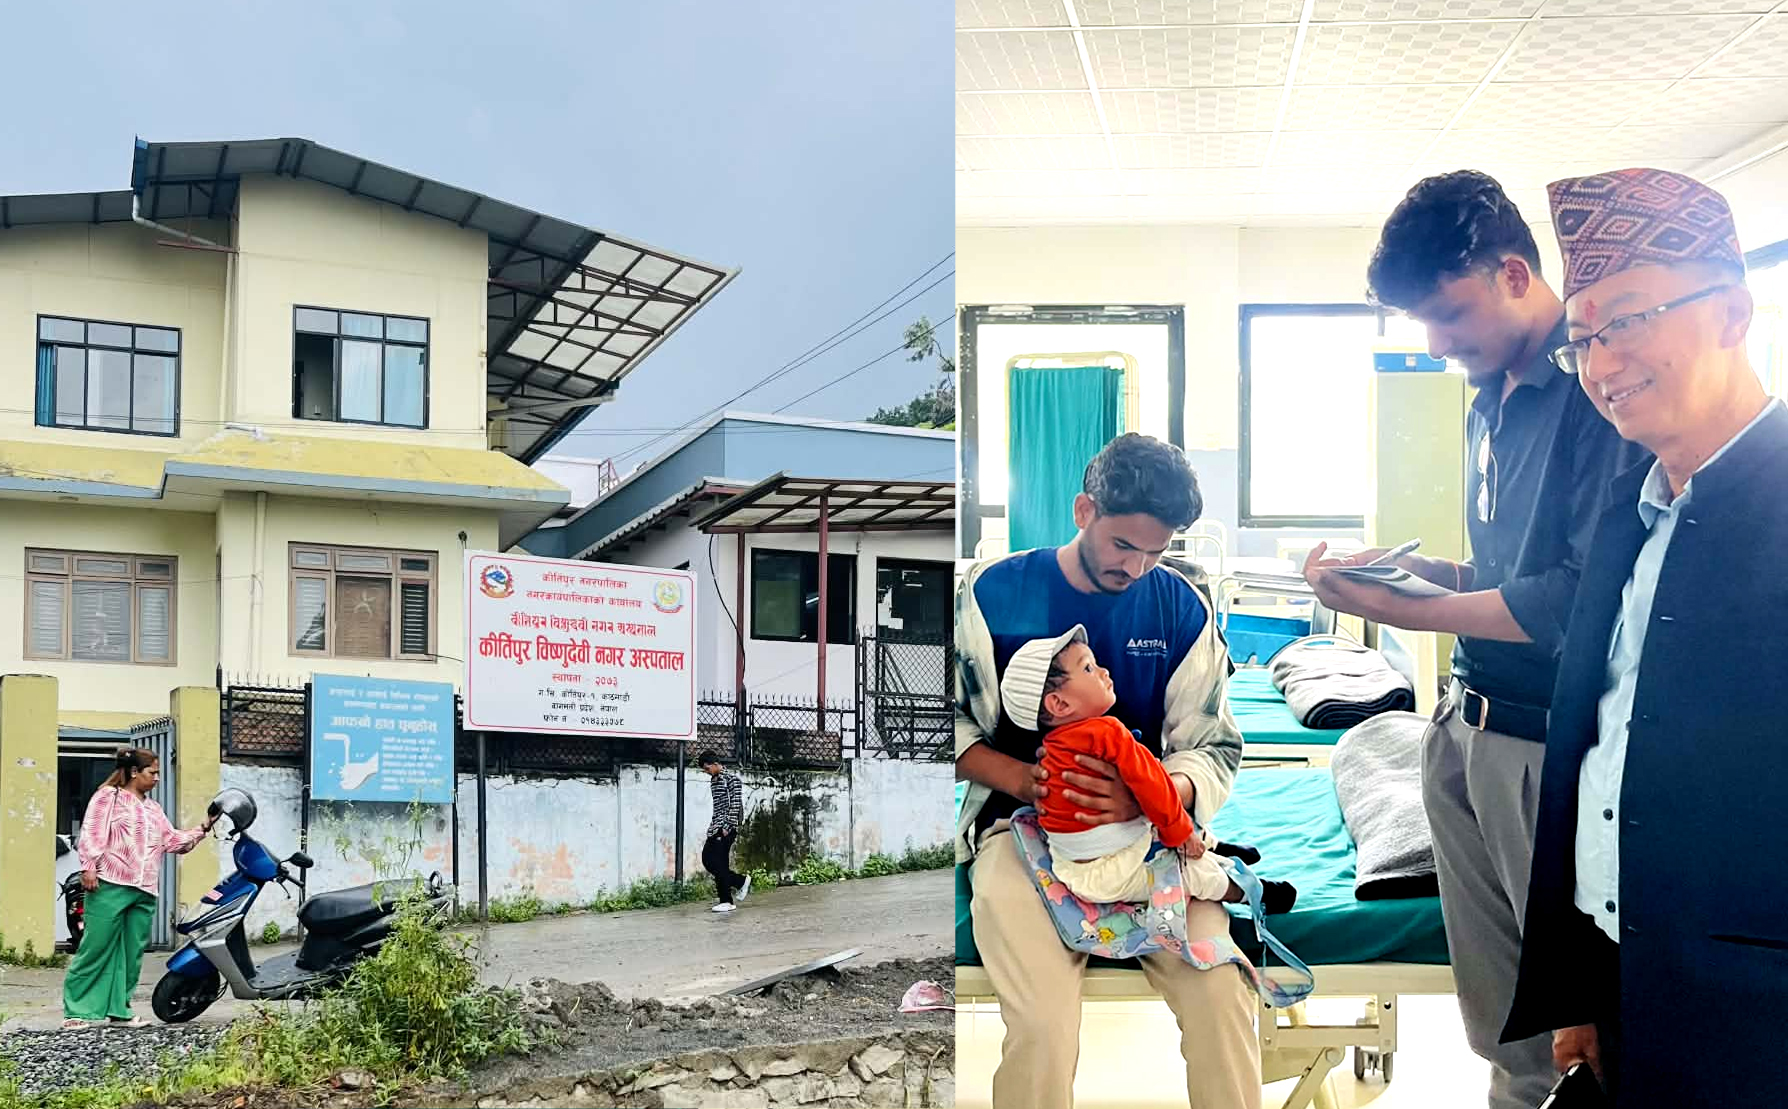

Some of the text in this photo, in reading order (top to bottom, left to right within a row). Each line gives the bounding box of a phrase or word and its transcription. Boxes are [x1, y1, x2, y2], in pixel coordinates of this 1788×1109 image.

[479, 632, 684, 671] कीर्तिपुर विष्णुदेवी नगर अस्पताल
[595, 676, 618, 687] २०७३
